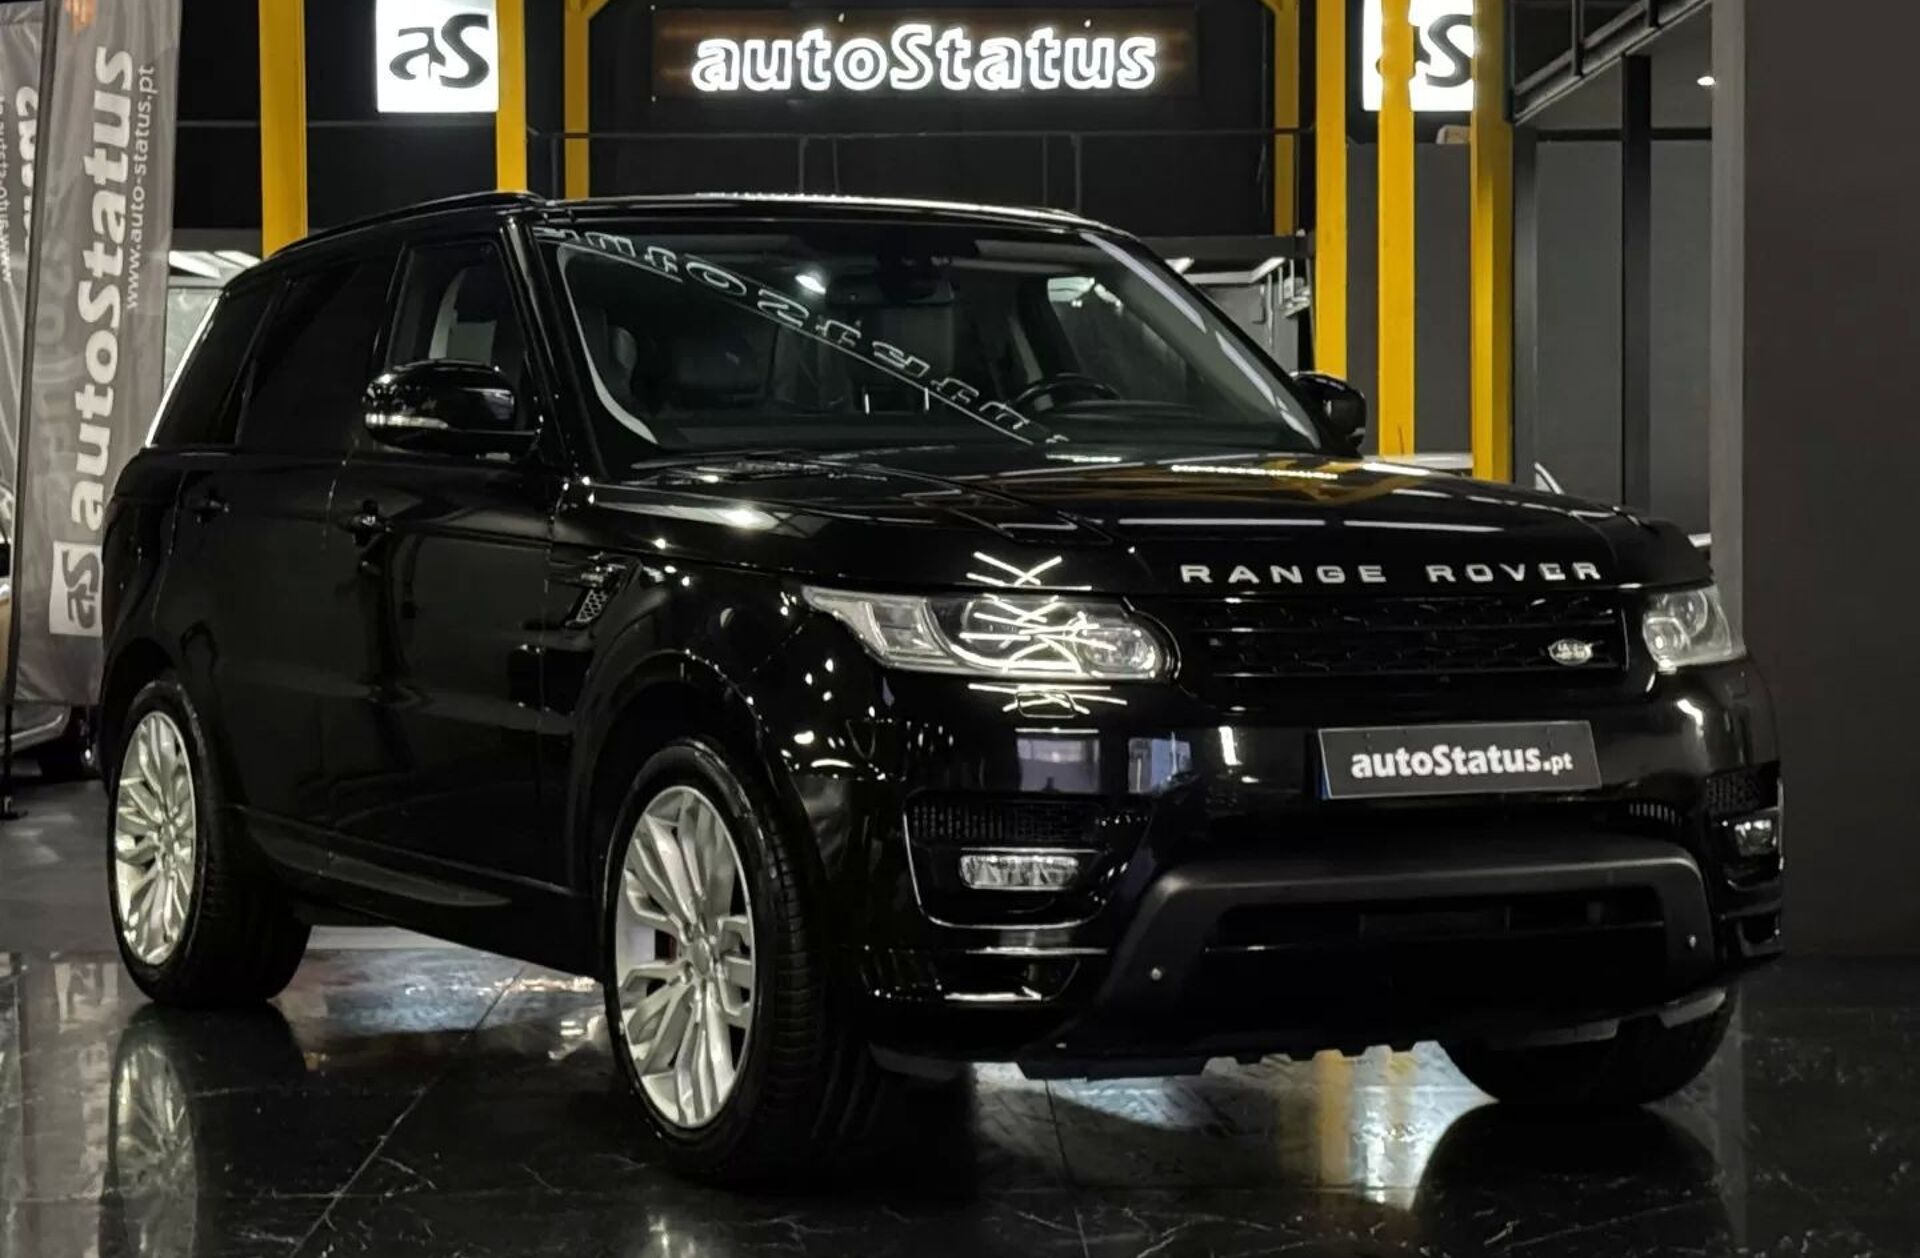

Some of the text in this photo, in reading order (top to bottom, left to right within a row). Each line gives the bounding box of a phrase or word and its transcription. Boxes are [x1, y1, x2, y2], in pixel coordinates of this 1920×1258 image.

[389, 13, 490, 89] aS
[692, 22, 1157, 92] autoStatus
[127, 65, 158, 310] www.auto-status.pt
[72, 47, 133, 530] autoStatus
[1180, 562, 1601, 583] RANGE ROVER
[1351, 744, 1574, 779] autoStatus.pt
